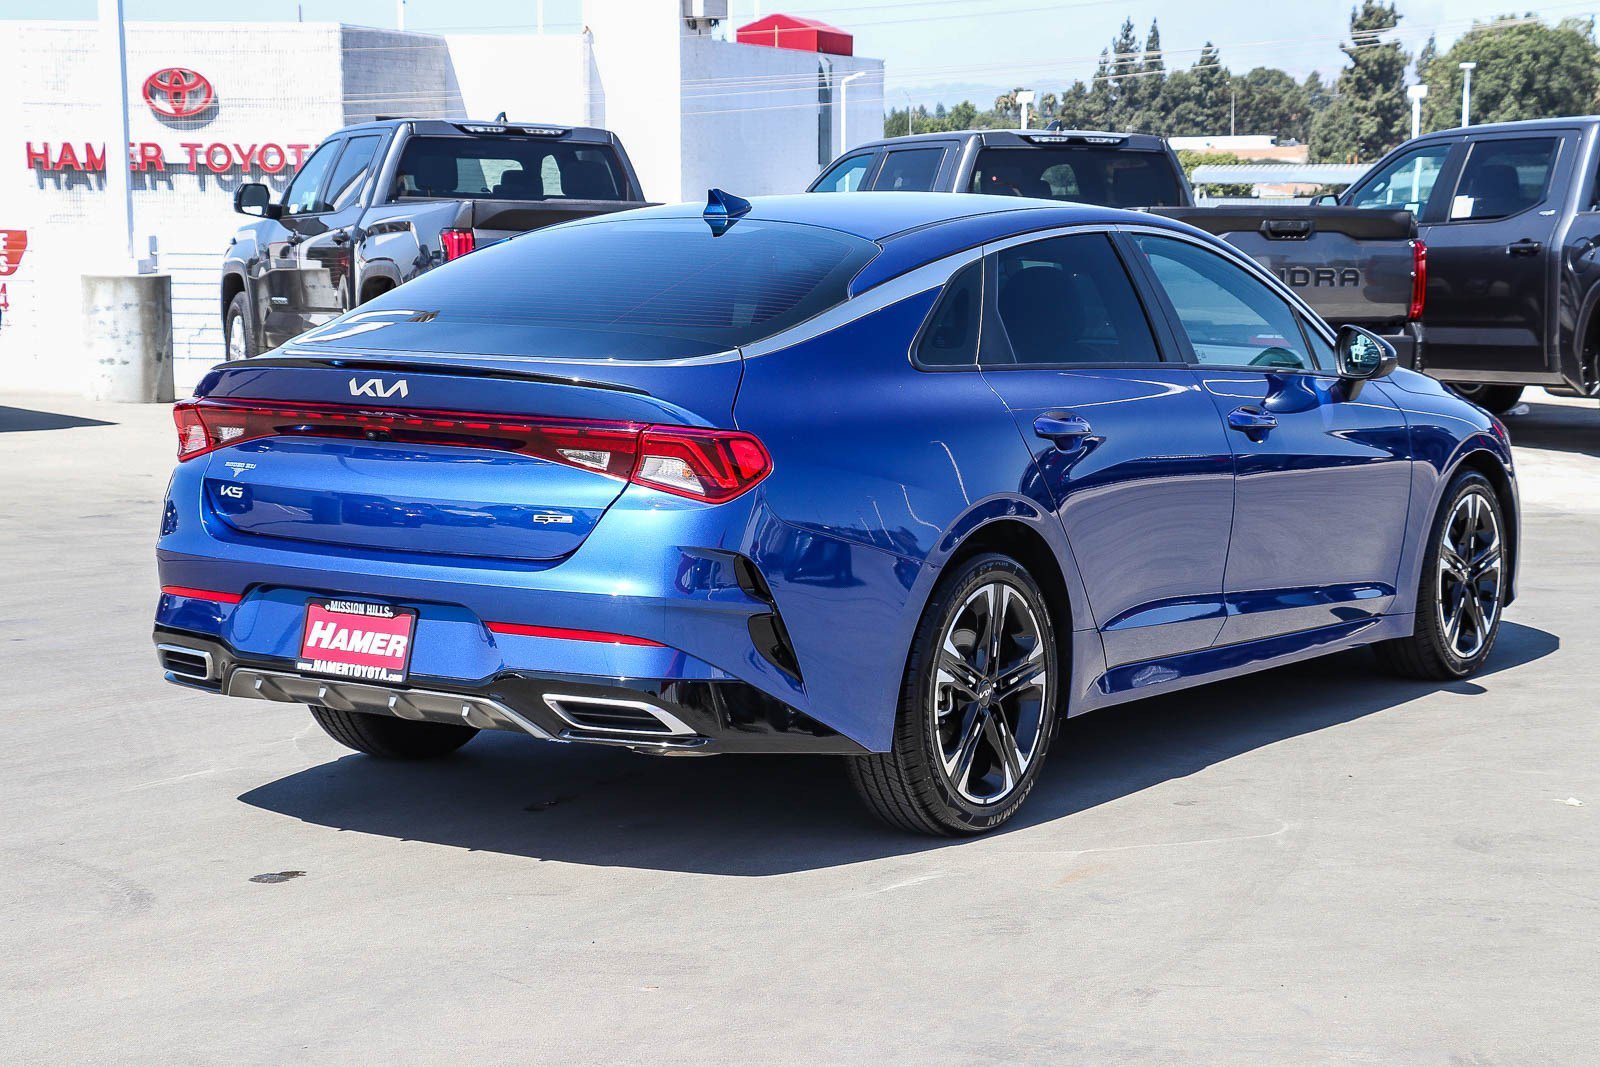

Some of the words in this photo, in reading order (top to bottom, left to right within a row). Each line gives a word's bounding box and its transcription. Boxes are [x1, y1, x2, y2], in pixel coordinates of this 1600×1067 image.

[180, 142, 318, 173] TOYOT
[1280, 267, 1361, 288] DRA
[348, 377, 409, 399] KIA
[220, 485, 243, 499] K5
[330, 600, 365, 615] MISSION
[366, 603, 390, 617] HILLS
[306, 620, 409, 658] HAMER
[296, 659, 403, 682] www.HAMERTOYOTA.com
[986, 779, 1034, 826] IRONMAN
